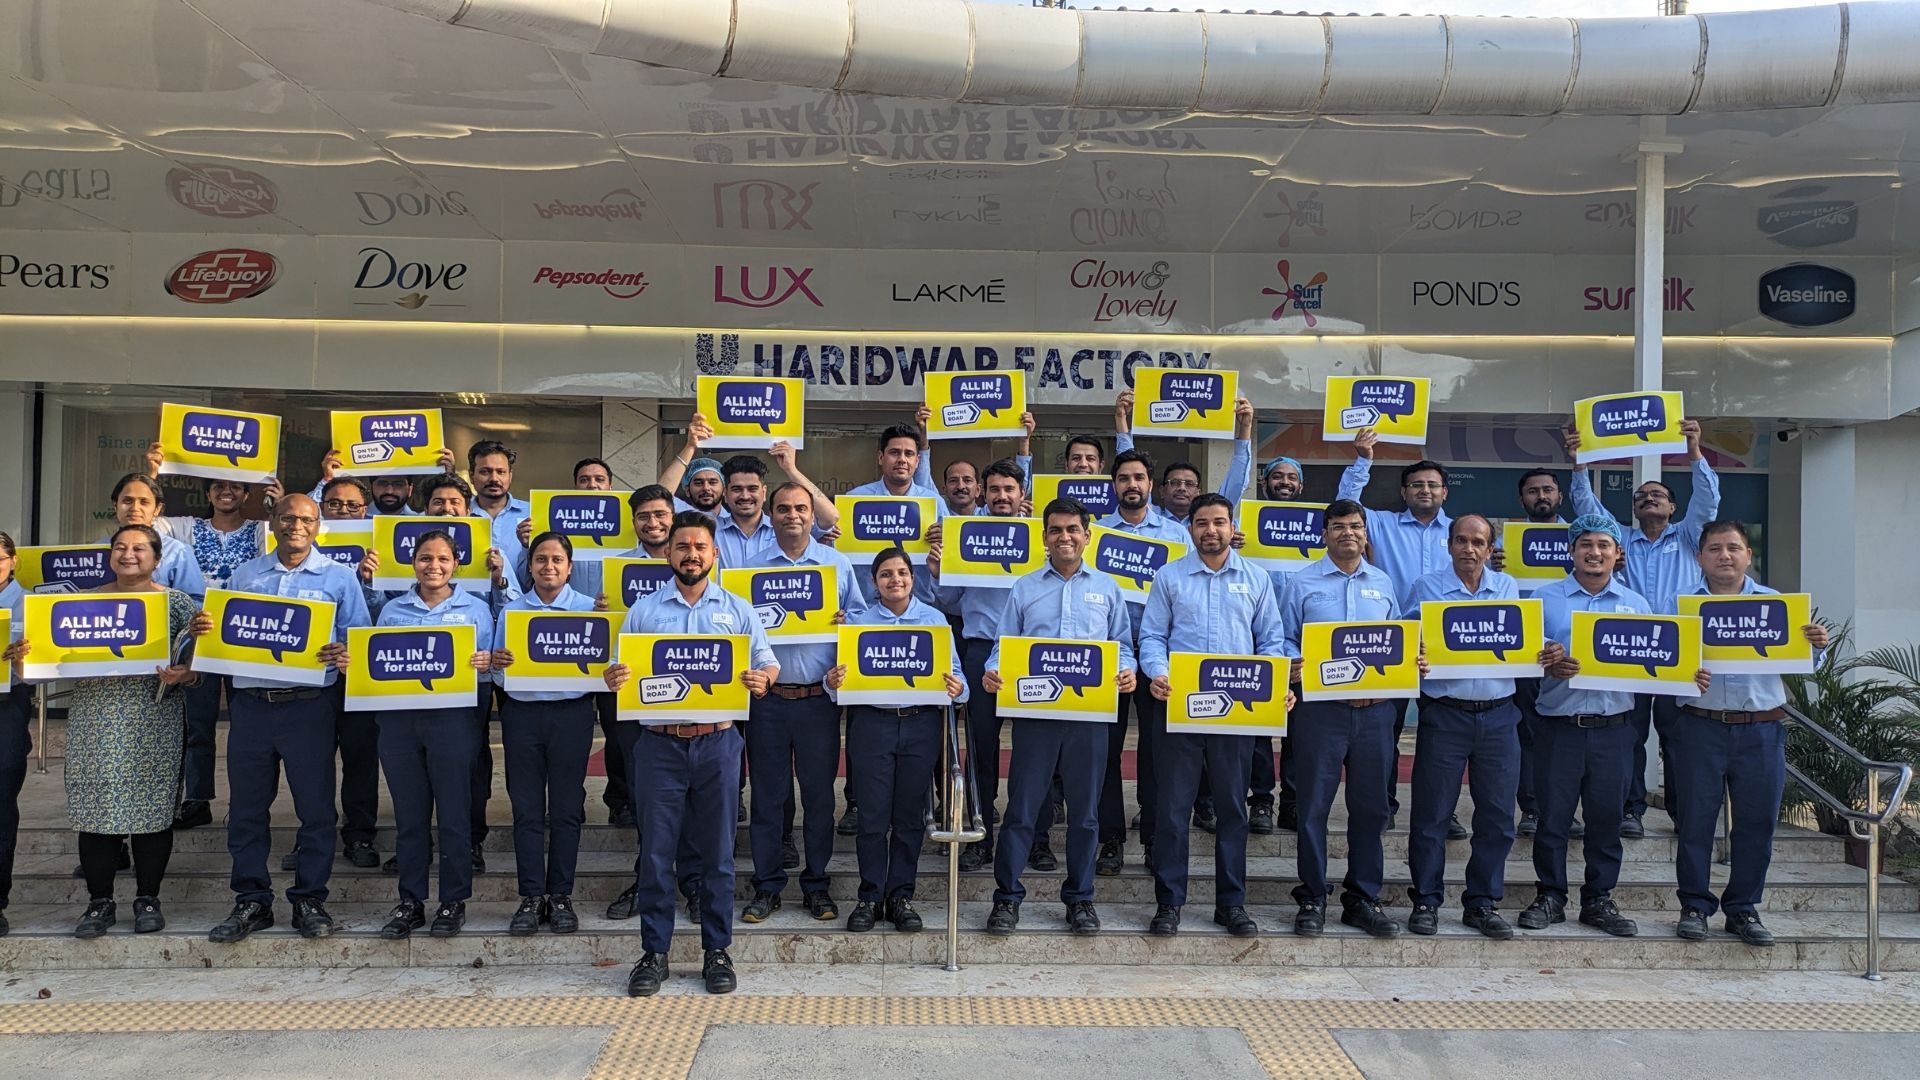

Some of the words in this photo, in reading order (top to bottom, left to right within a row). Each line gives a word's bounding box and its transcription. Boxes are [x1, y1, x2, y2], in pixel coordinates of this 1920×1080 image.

[354, 247, 468, 290] Dove
[177, 268, 270, 284] Lifebuoy
[532, 266, 646, 288] Pepsodent
[714, 265, 824, 308] LUX
[892, 278, 1006, 303] LAKMÉ
[1293, 284, 1324, 298] Surf
[1412, 280, 1521, 307] POND'S
[1094, 290, 1178, 326] Lovely
[1293, 298, 1322, 310] excel
[960, 381, 979, 390] ALL
[1170, 380, 1190, 390] ALL
[1362, 386, 1382, 396] ALL
[962, 392, 974, 400] for
[976, 392, 1002, 400] safety
[1172, 390, 1185, 398] for
[1186, 390, 1214, 400] safety
[1362, 396, 1376, 404] for
[1376, 396, 1405, 406] safety
[722, 396, 747, 407] ALL
[730, 406, 746, 417] for
[748, 407, 782, 420] safety
[1598, 412, 1622, 423] ALL
[370, 420, 393, 430] ALL
[1606, 420, 1622, 431] for
[1624, 417, 1660, 430] safety
[188, 424, 214, 438] ALL
[373, 430, 388, 438] for
[388, 430, 418, 440] safety
[196, 436, 214, 448] for
[214, 440, 254, 454] safety
[1066, 486, 1088, 495] ALL
[1082, 496, 1110, 506] safety
[555, 508, 578, 520] ALL
[858, 514, 882, 525] ALL
[562, 519, 579, 530] for
[580, 520, 615, 532] safety
[866, 524, 882, 534] for
[882, 524, 916, 536] safety
[1264, 520, 1288, 530] ALL
[966, 536, 990, 546] ALL
[1270, 530, 1286, 540] for
[1288, 532, 1322, 544] safety
[1528, 540, 1550, 551] ALL
[972, 546, 988, 556] for
[990, 546, 1024, 558] safety
[1103, 547, 1126, 562] ALL
[52, 558, 78, 568] ALL
[1108, 558, 1124, 570] for
[56, 568, 72, 578] for
[72, 568, 106, 578] safety
[762, 579, 786, 590] ALL
[765, 590, 780, 600] for
[781, 590, 812, 601] safety
[60, 616, 92, 628] ALL
[229, 614, 258, 628] ALL
[1707, 616, 1736, 628] ALL
[1450, 622, 1476, 633] ALL
[70, 628, 92, 640] for
[94, 628, 140, 641] safety
[236, 628, 257, 640] for
[258, 631, 301, 646] safety
[534, 632, 562, 644] ALL
[1342, 634, 1365, 644] ALL
[1459, 632, 1479, 644] for
[1479, 632, 1518, 645] safety
[1600, 634, 1628, 646] ALL
[1716, 628, 1738, 639] for
[1738, 628, 1782, 640] safety
[376, 650, 404, 662] ALL
[543, 644, 562, 656] for
[564, 645, 604, 658] safety
[665, 648, 692, 660] ALL
[864, 647, 890, 658] ALL
[1040, 650, 1064, 662] ALL
[1344, 645, 1360, 654] for
[1360, 645, 1392, 655] safety
[1608, 646, 1628, 656] for
[1630, 648, 1672, 661] safety
[384, 660, 405, 672] for
[406, 660, 448, 673] safety
[667, 660, 685, 670] for
[685, 660, 721, 672] safety
[872, 658, 890, 668] for
[890, 658, 928, 671] safety
[1042, 663, 1058, 673] for
[1059, 664, 1091, 676] safety
[1210, 666, 1235, 678] ALL
[1326, 672, 1345, 680] ROAD
[658, 682, 672, 690] THE
[1212, 678, 1228, 688] for
[1230, 680, 1262, 692] safety
[646, 690, 668, 698] ROAD
[1023, 690, 1042, 698] ROAD
